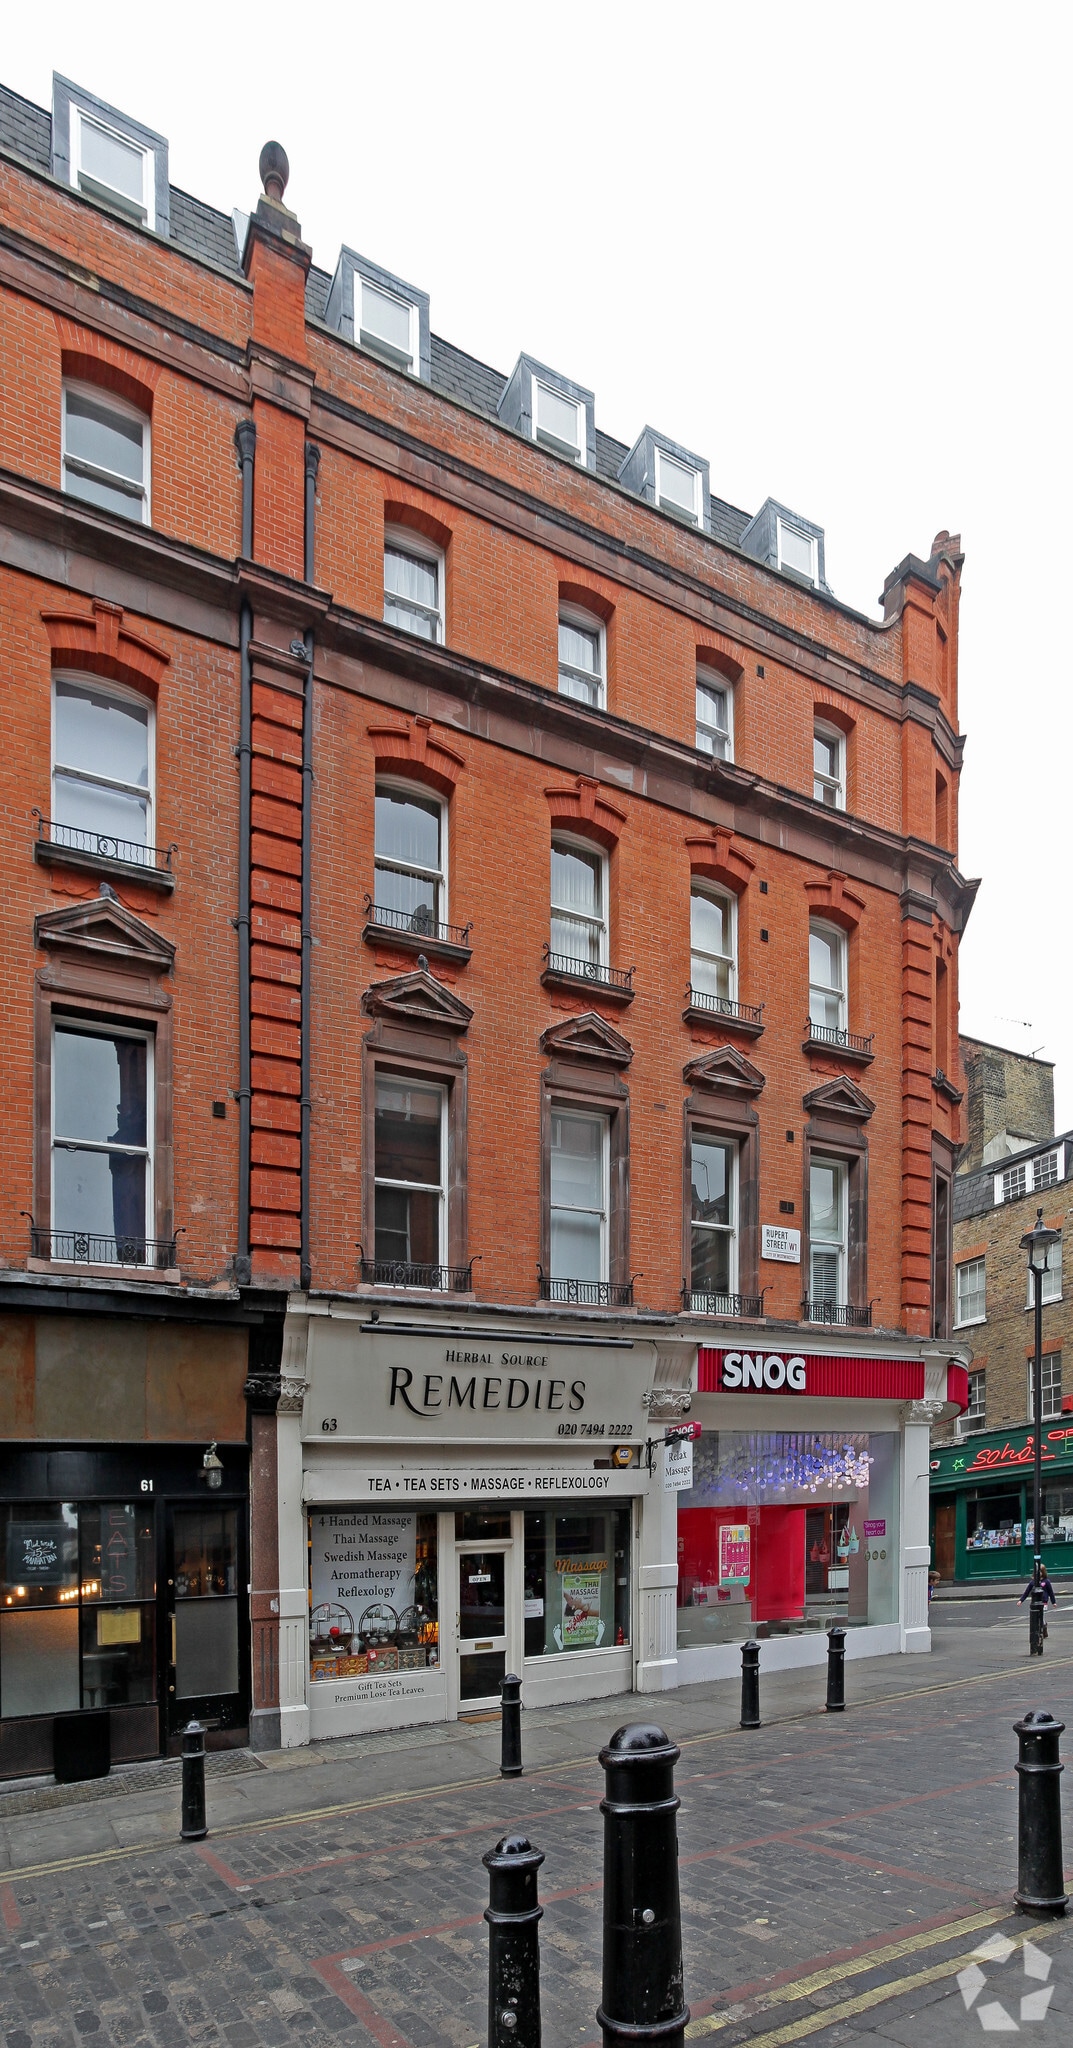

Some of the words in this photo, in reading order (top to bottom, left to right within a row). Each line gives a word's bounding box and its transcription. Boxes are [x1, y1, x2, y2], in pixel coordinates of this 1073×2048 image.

[766, 1229, 788, 1240] RUPERT
[766, 1239, 787, 1250] STREET
[789, 1242, 797, 1251] W1
[446, 1350, 494, 1364] HERBAL
[501, 1353, 548, 1367] SOURCE
[723, 1352, 806, 1390] SNOG
[388, 1366, 586, 1416] REMEDIES
[321, 1418, 337, 1431] 63
[558, 1424, 577, 1435] 020
[580, 1424, 605, 1435] 7494
[608, 1424, 633, 1436] 2222
[668, 1449, 687, 1462] Relax
[665, 1465, 691, 1477] Massage
[141, 1479, 153, 1491] 61
[368, 1478, 392, 1491] TEA
[404, 1478, 427, 1491] TEA
[430, 1478, 460, 1491] SETS
[471, 1477, 525, 1490] MASSAGE
[535, 1476, 610, 1489] REFLEXOLOGY
[372, 1515, 412, 1528] Massage
[333, 1533, 356, 1545] Thai
[359, 1533, 399, 1546] Massage
[324, 1551, 365, 1562] Swedish
[367, 1551, 408, 1563] Massage
[556, 1559, 608, 1574] Massage
[331, 1568, 401, 1581] Aromatherapy
[337, 1585, 396, 1598] Reflexology
[570, 1588, 599, 1596] MASSAGE
[358, 1681, 372, 1691] Gift
[374, 1681, 386, 1689] Tea
[388, 1680, 402, 1688] Sets
[334, 1692, 369, 1703] Premium
[370, 1690, 387, 1699] Lose
[388, 1689, 400, 1697] Tea
[402, 1687, 425, 1696] Leaves
